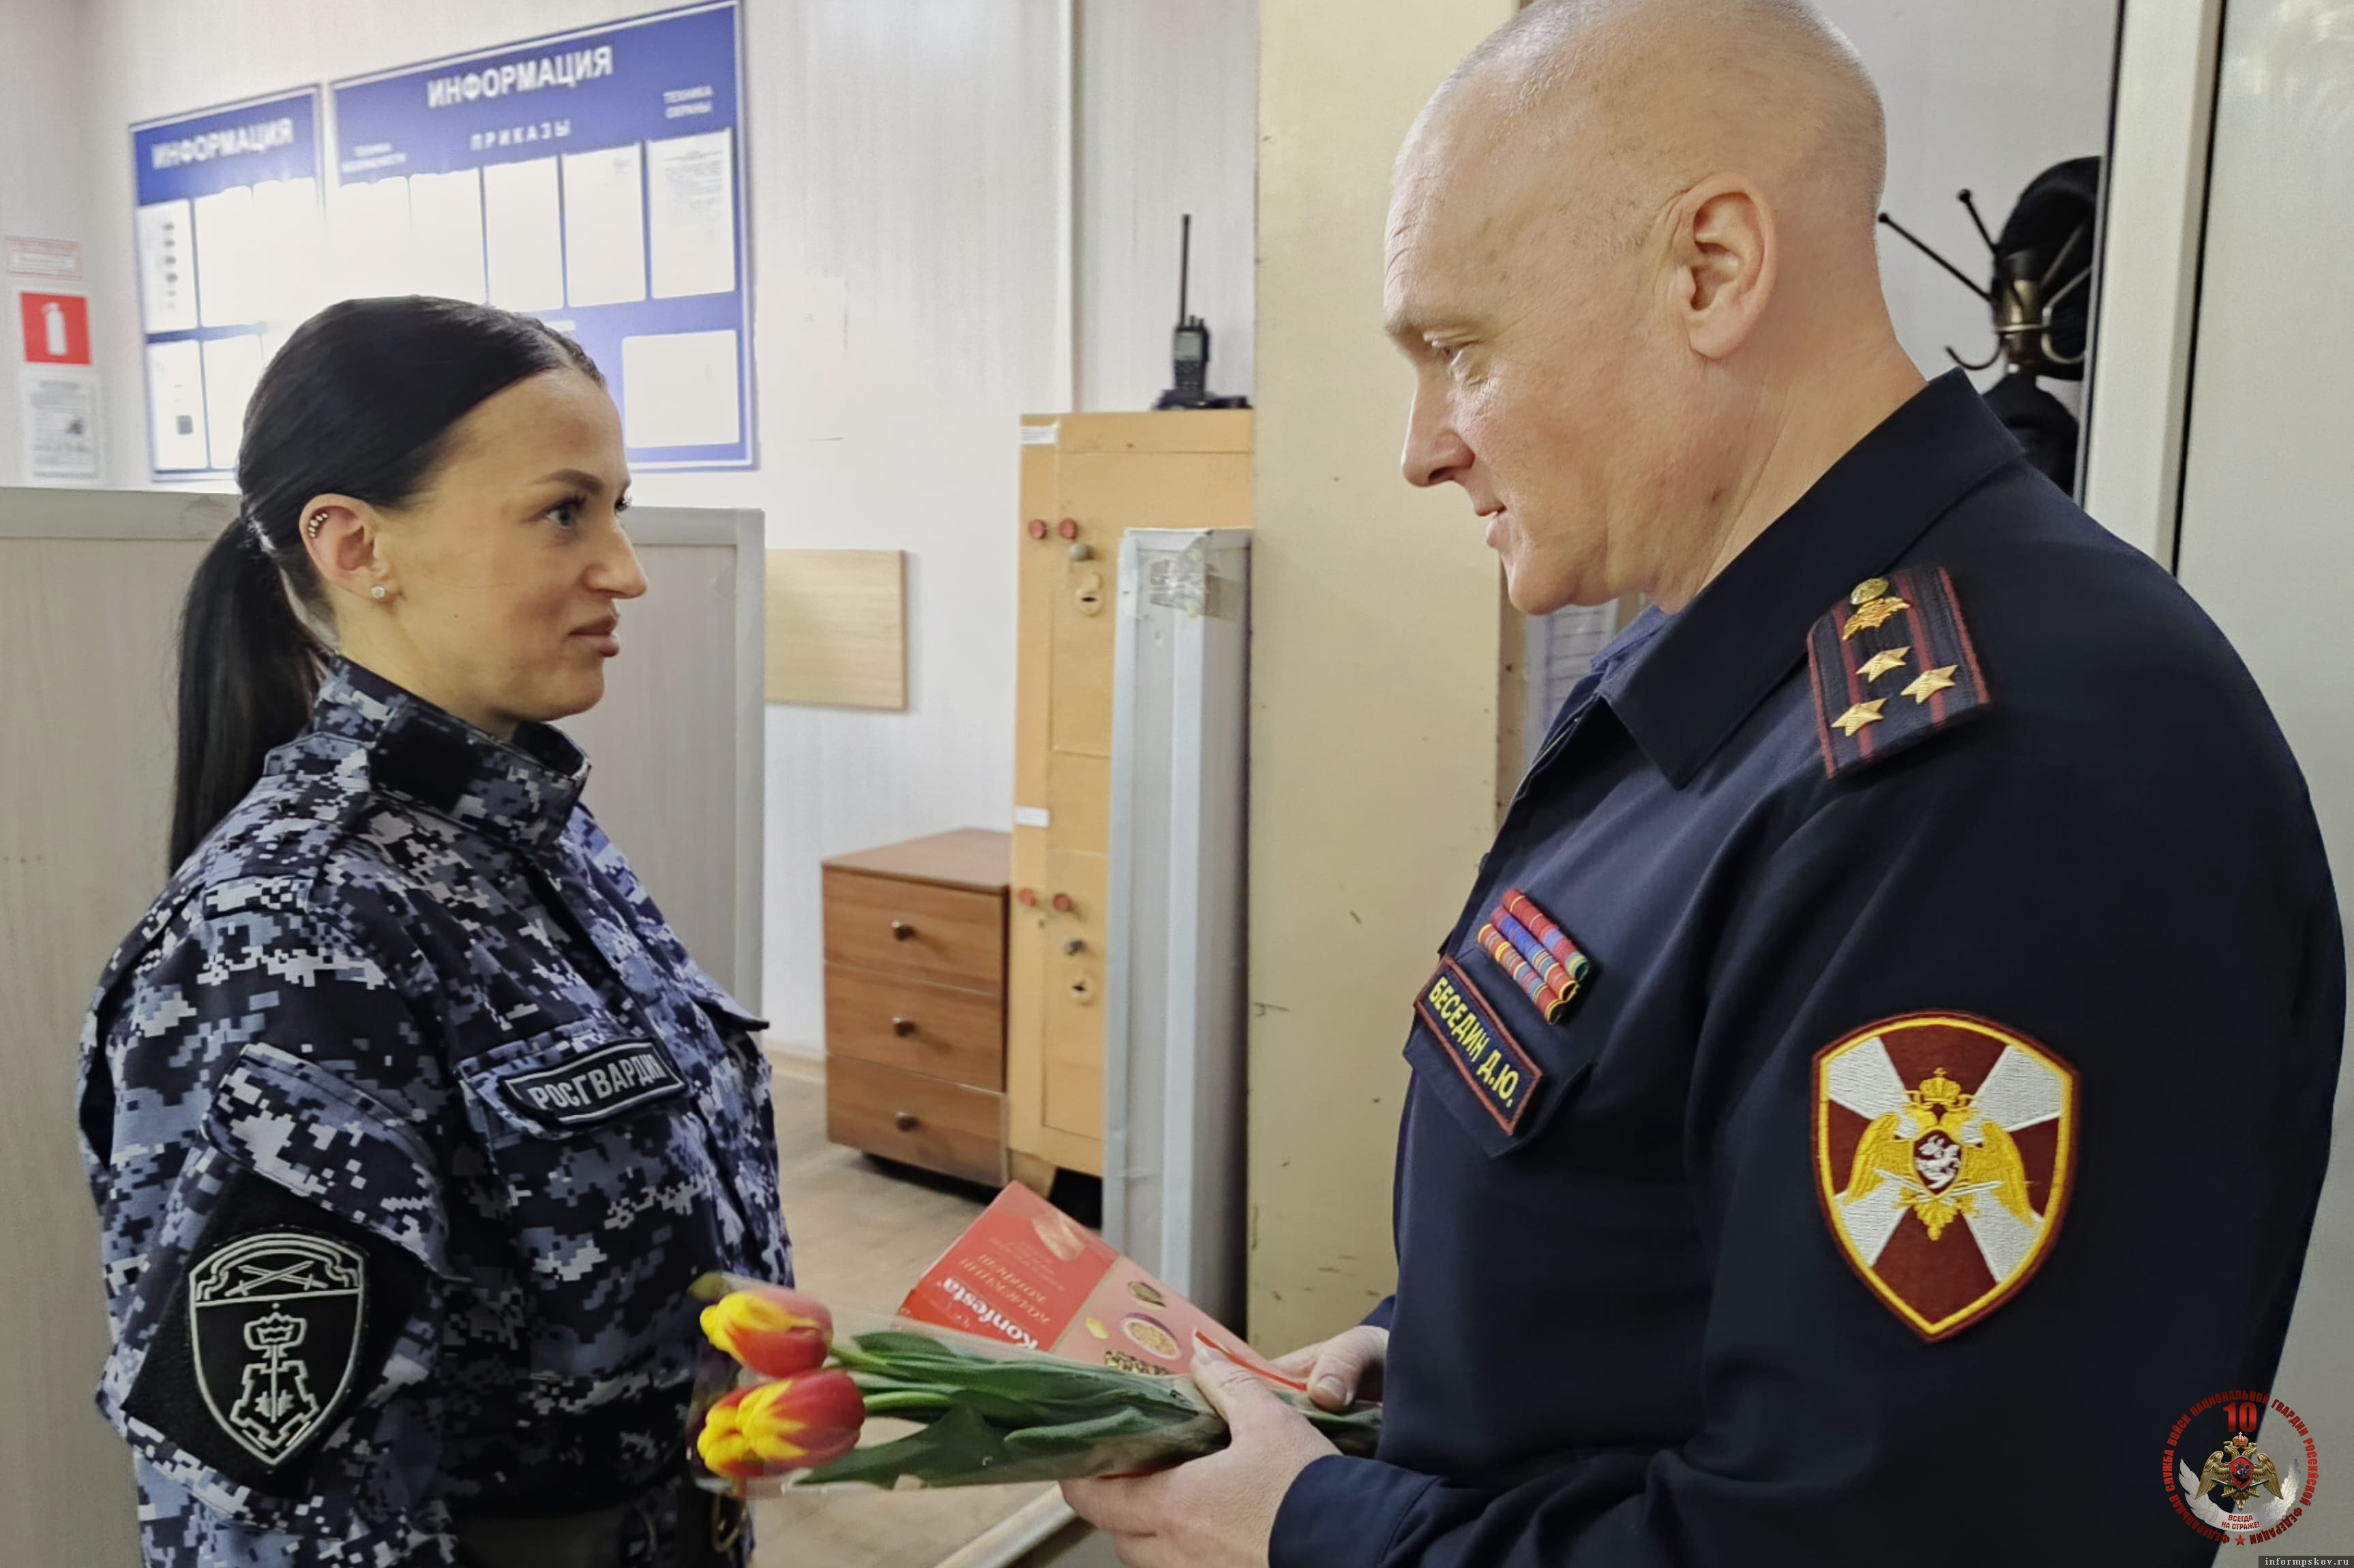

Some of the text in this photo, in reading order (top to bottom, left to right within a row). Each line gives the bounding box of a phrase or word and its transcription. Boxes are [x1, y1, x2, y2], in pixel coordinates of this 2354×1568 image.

[427, 45, 614, 108] ИНФОРМАЦИЯ
[151, 117, 293, 170] ИНФОРМАЦИЯ
[470, 119, 571, 151] ПРИКАЗЫ
[1429, 976, 1519, 1108] БЕСЕДИН Д.Ю.
[943, 1278, 1038, 1350] Konfesta
